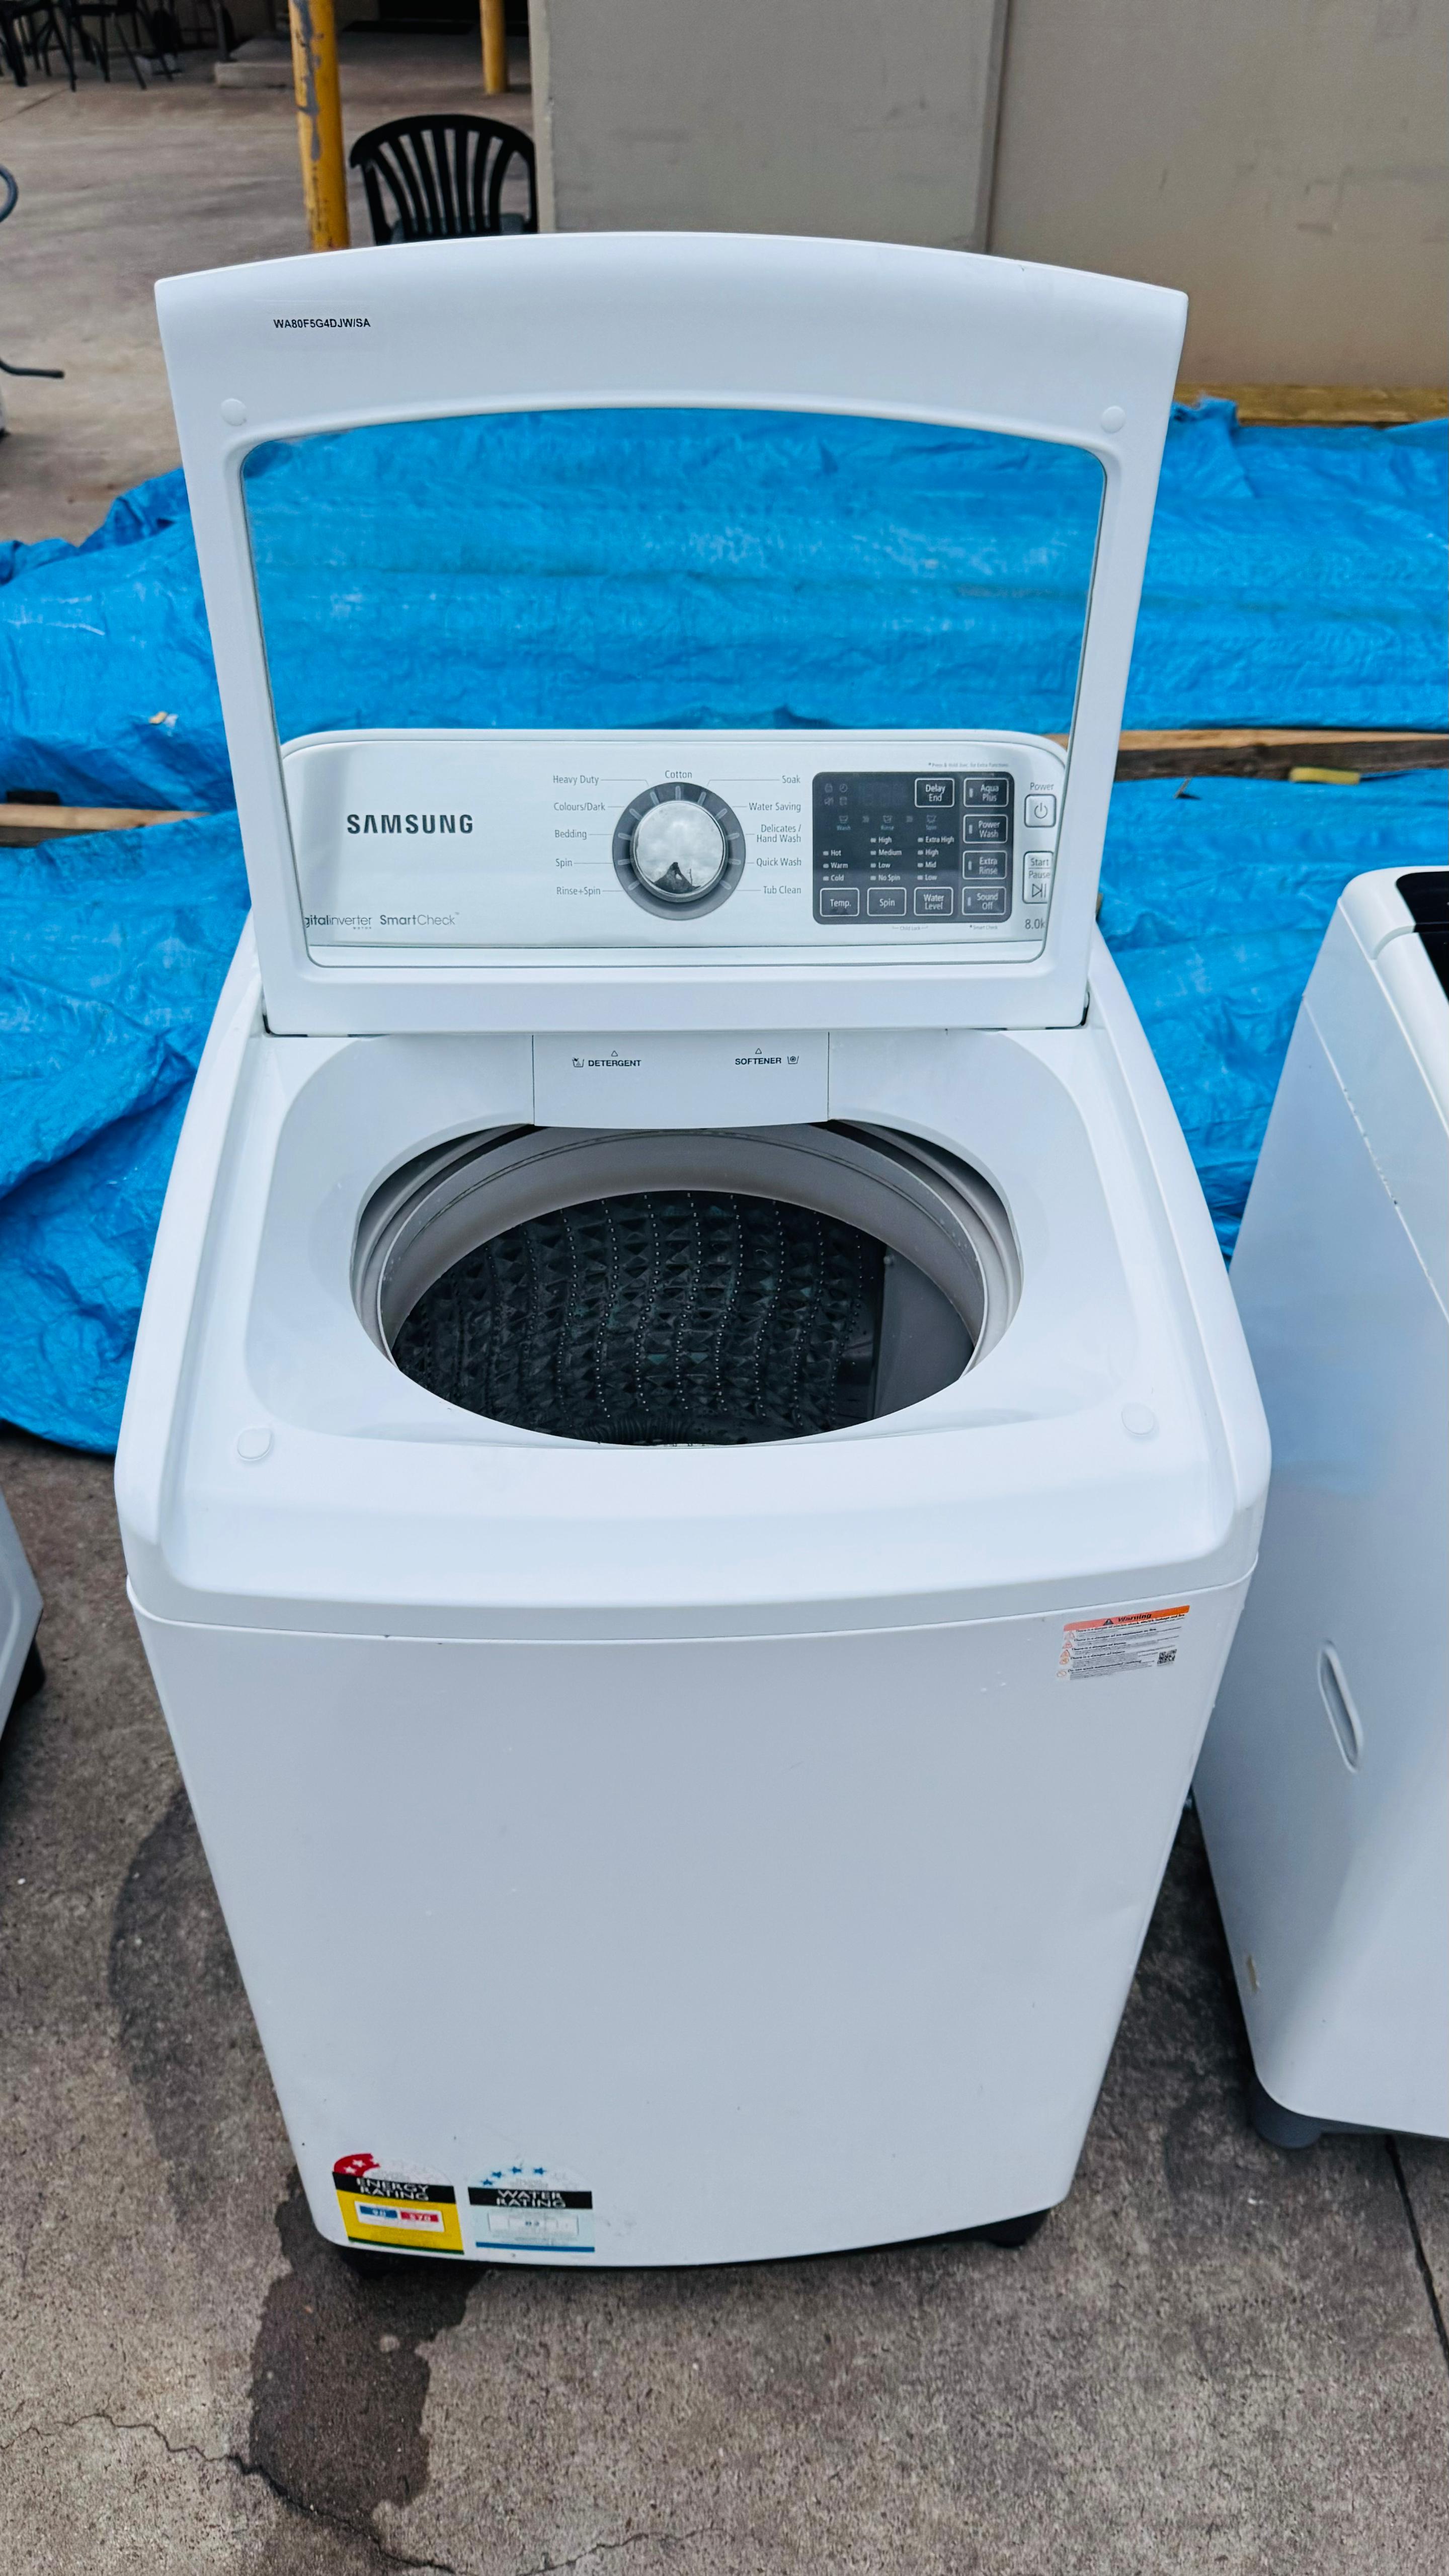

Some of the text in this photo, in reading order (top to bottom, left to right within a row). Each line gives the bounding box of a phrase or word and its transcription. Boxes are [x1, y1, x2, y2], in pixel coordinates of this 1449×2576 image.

[665, 770, 692, 779] Cotton
[782, 775, 801, 783] Soak
[553, 775, 599, 786] Heavy Duty
[926, 784, 946, 794] Delay
[981, 784, 999, 793] Aqua
[1030, 782, 1055, 790] Power
[982, 793, 997, 801] Plus
[554, 802, 606, 812] Colours/Dark
[749, 802, 801, 813] Water Saving
[347, 814, 473, 834] SAMSUNG
[761, 824, 796, 833] Delicates
[978, 820, 1000, 828] Power
[554, 829, 587, 840] Bedding
[756, 834, 801, 843] Hand Wash
[980, 830, 999, 838] Wash
[941, 836, 954, 844] High
[925, 849, 939, 857] High
[555, 858, 573, 868] Spin
[756, 857, 801, 867] Quick Wash
[979, 857, 998, 865] Extra
[1030, 858, 1049, 866] Start
[979, 866, 998, 874] Rinse
[1028, 871, 1051, 879] Pause
[556, 886, 601, 897] Rinse+Spin
[763, 886, 801, 894] Tub Clean
[924, 894, 944, 902] Water
[977, 893, 999, 901] Sound
[830, 899, 851, 908] Temp.
[879, 899, 896, 908] Spin
[925, 902, 943, 910] Level
[982, 902, 993, 910] Off
[735, 1057, 782, 1065] SOFTENER
[1117, 1614, 1152, 1623] Warning
[356, 2178, 429, 2193] ENERGY
[360, 2186, 429, 2201] RATING
[497, 2189, 561, 2199] WATER
[496, 2197, 566, 2208] RATING
